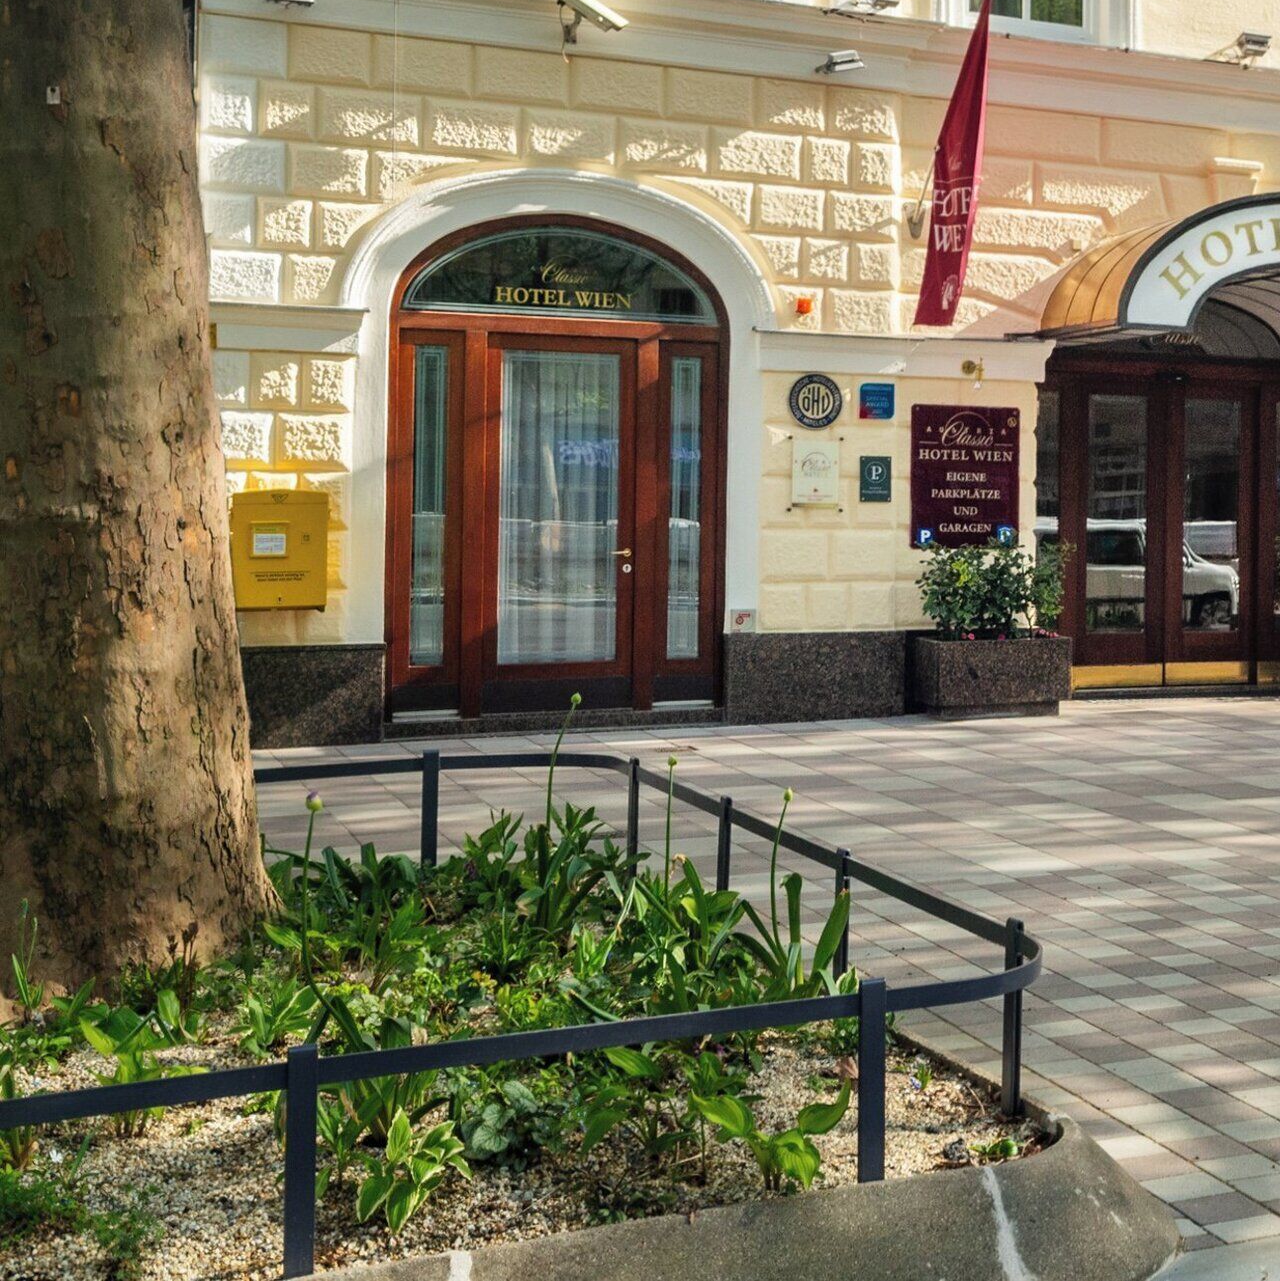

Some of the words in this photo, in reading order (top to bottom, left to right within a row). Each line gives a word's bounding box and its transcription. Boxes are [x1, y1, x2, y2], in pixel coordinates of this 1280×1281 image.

[495, 285, 571, 307] HOTEL
[575, 290, 632, 310] WIEN
[941, 421, 994, 447] Classic
[919, 448, 969, 461] HOTEL
[973, 450, 1013, 462] WIEN
[946, 472, 987, 482] EIGENE
[931, 488, 1001, 499] PARKPLÄTZE
[953, 506, 978, 516] UND
[939, 522, 992, 533] GARAGEN
